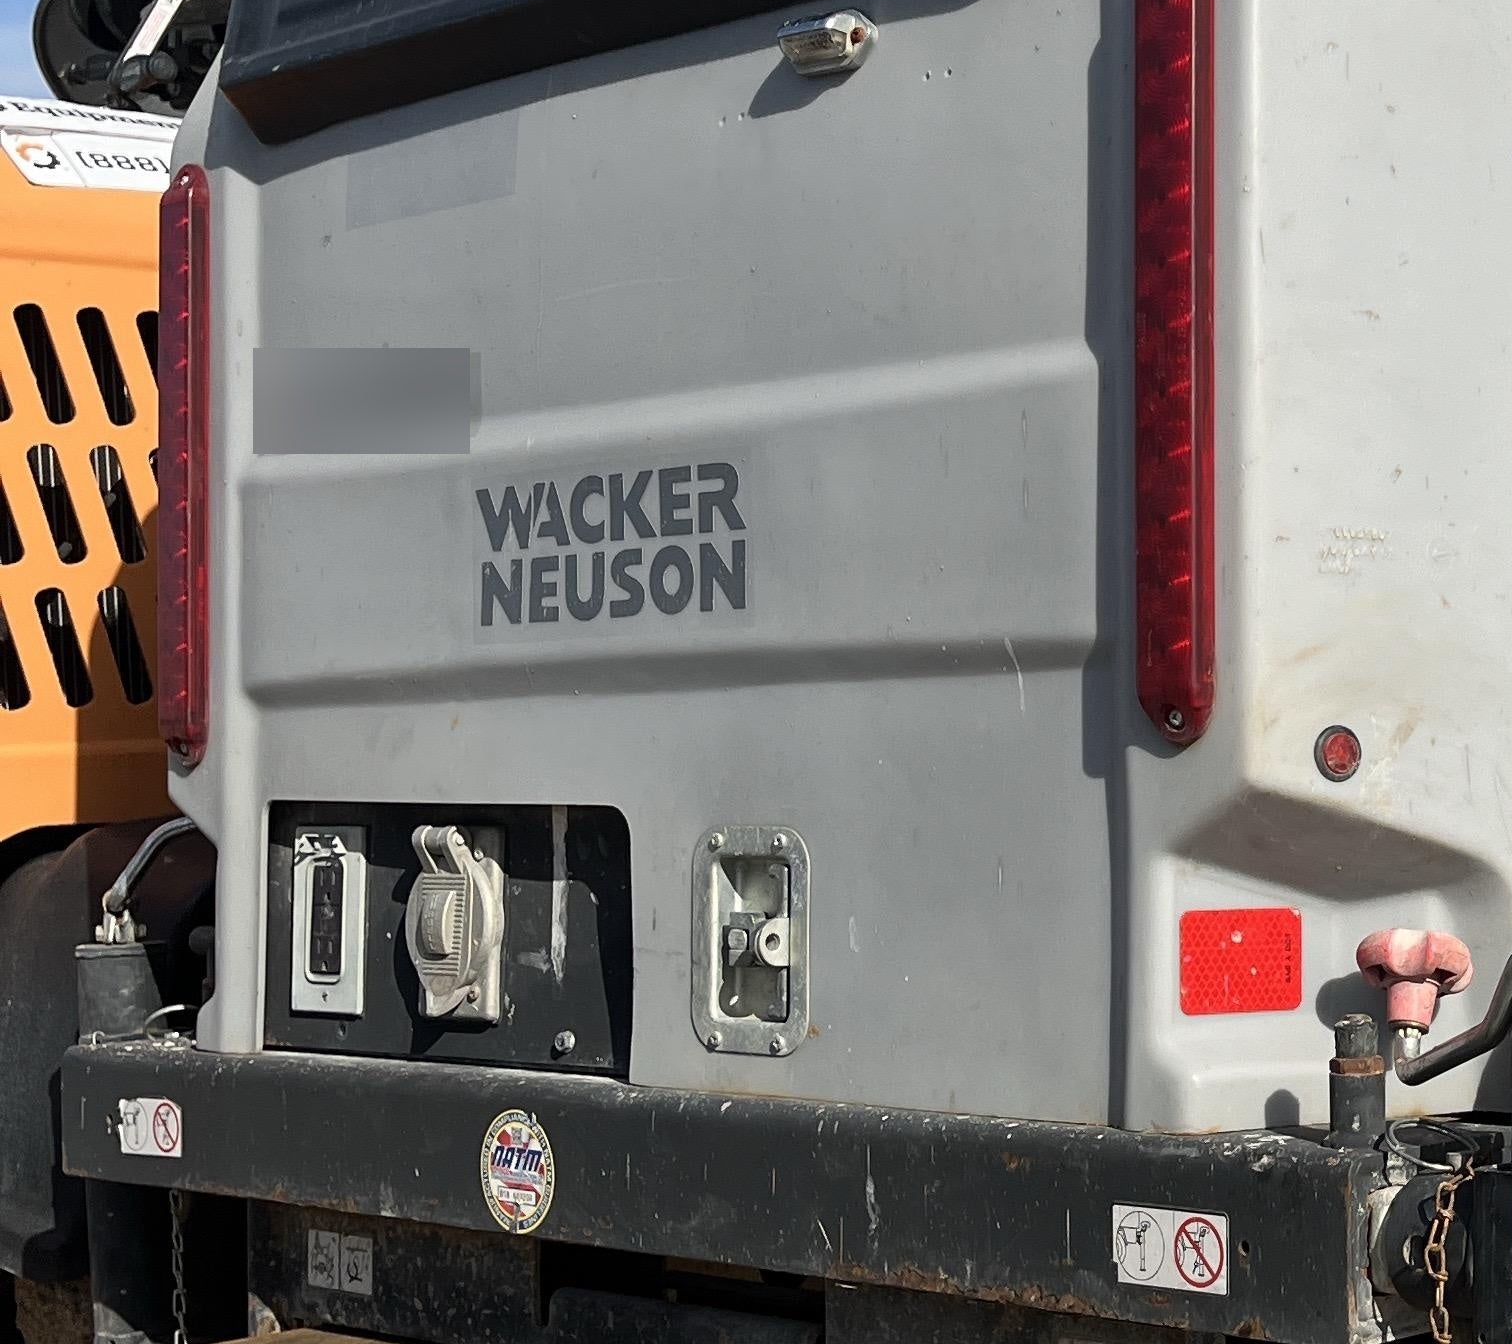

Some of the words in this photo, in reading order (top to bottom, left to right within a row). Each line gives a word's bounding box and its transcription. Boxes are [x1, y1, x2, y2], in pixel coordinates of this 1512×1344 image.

[76, 151, 170, 174] (888)
[475, 463, 747, 552] WACKER
[481, 539, 746, 627] NEUSON
[491, 1145, 543, 1173] NATM
